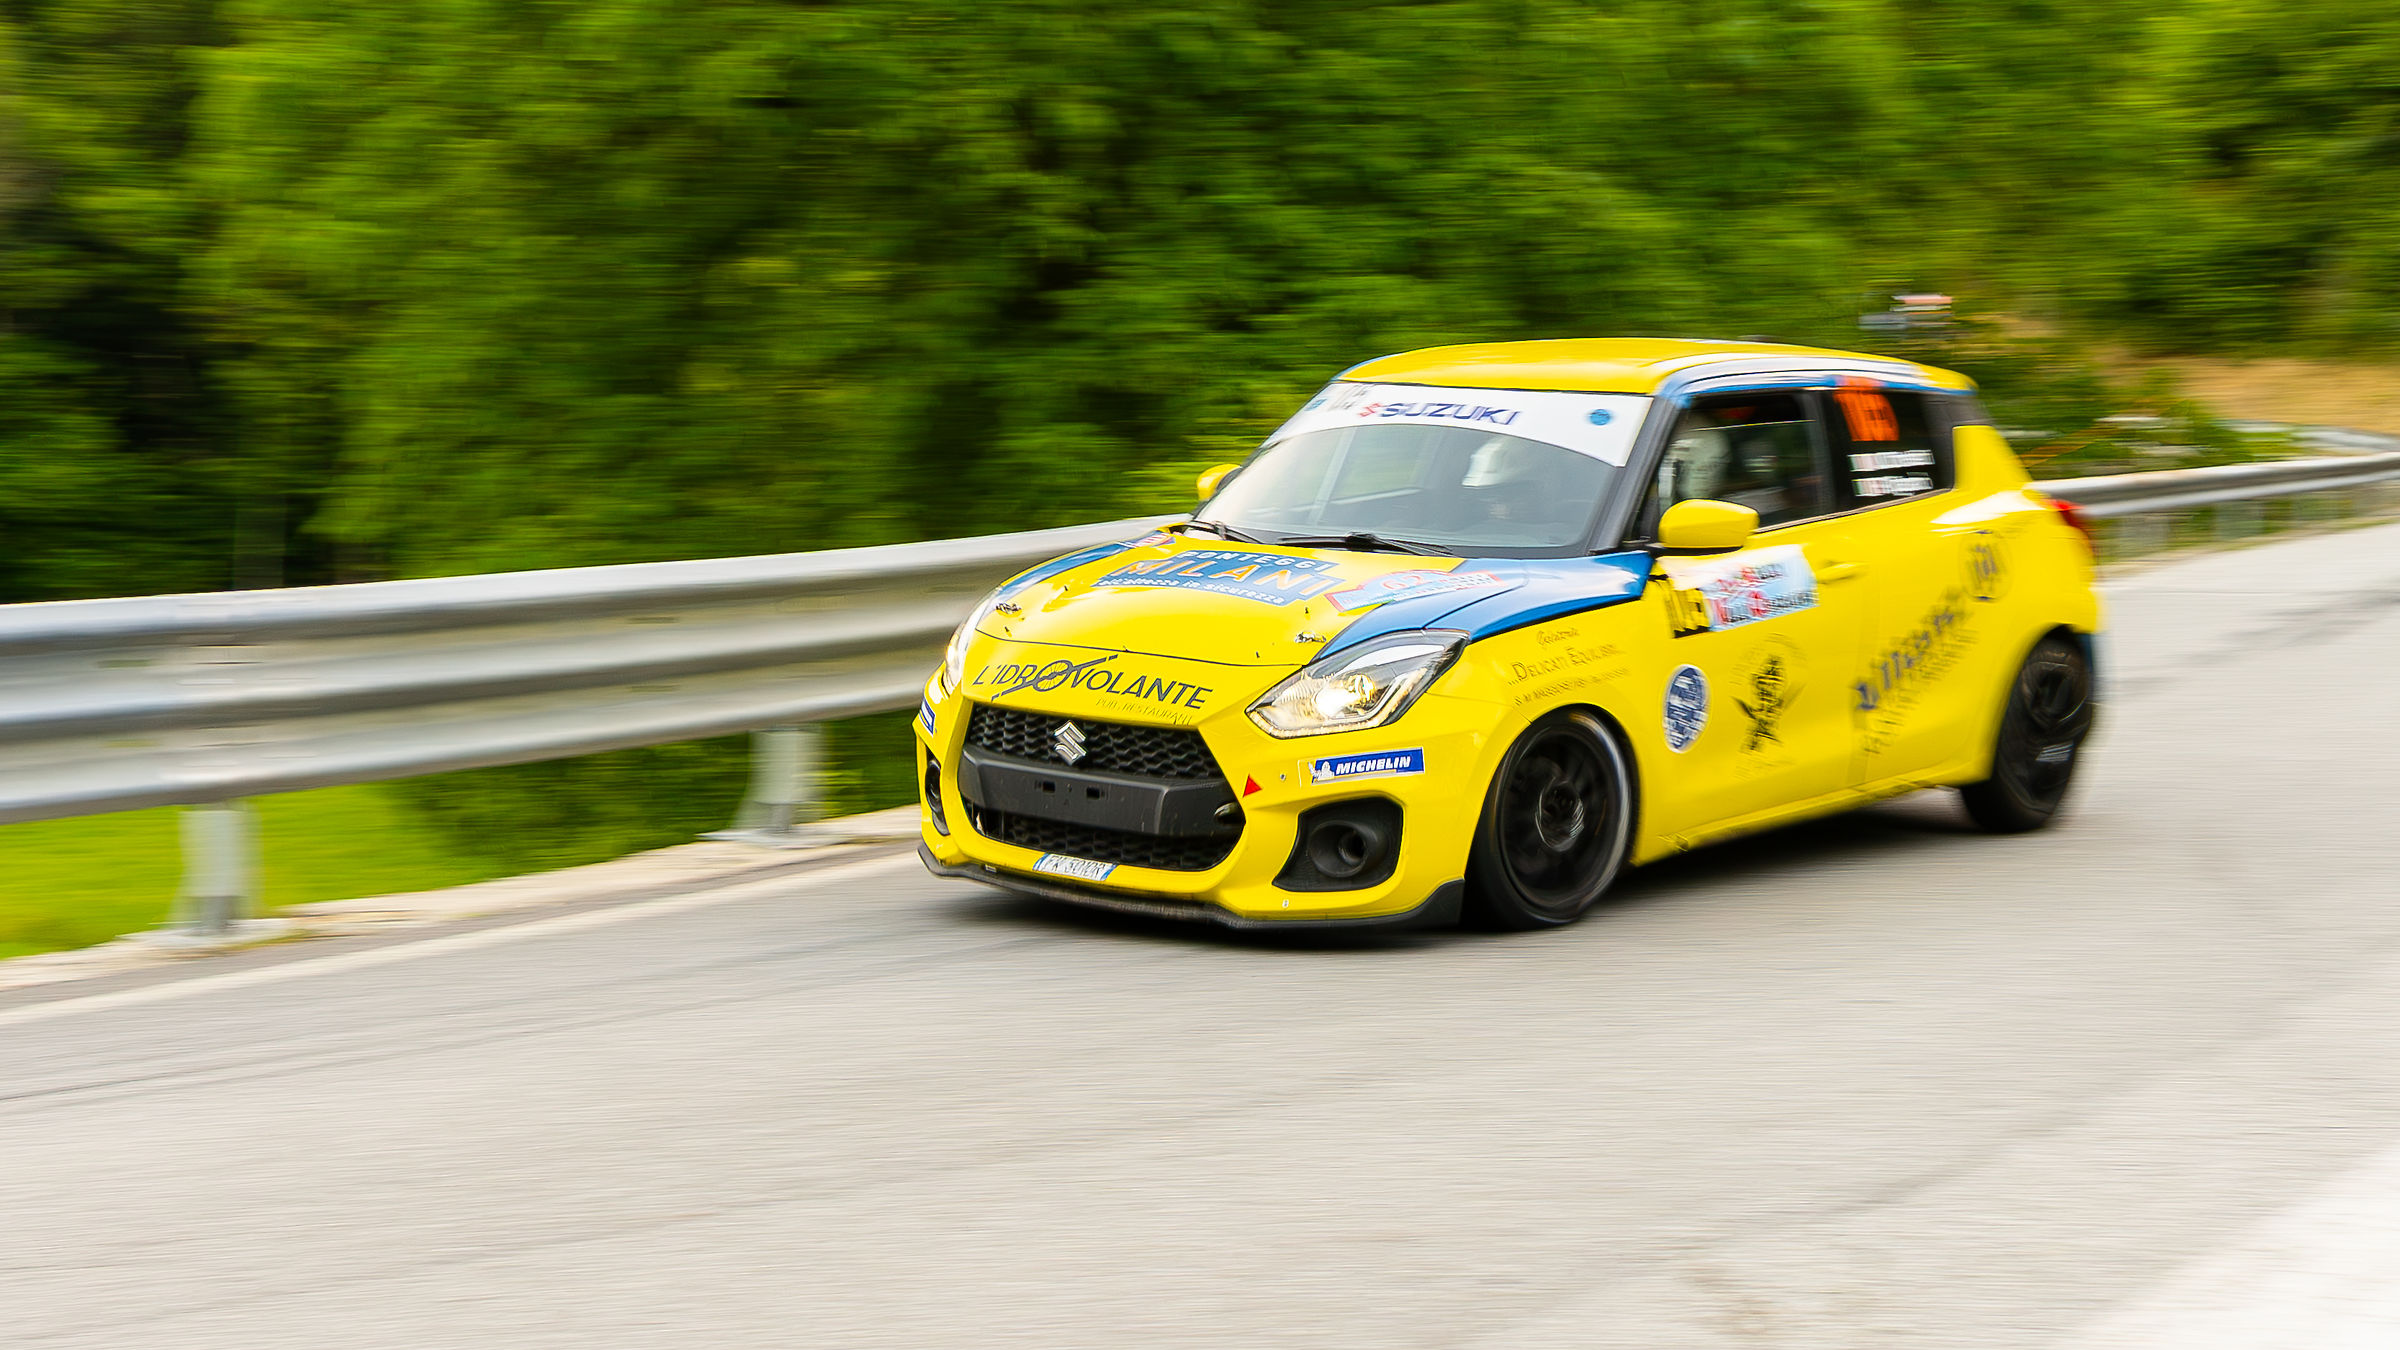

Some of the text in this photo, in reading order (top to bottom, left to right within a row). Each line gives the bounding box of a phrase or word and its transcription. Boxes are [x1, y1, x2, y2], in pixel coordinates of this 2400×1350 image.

[1380, 402, 1521, 425] SUZUKI
[1176, 551, 1330, 571] PONTEGGI
[1110, 560, 1335, 596] MILANI
[1204, 583, 1285, 604] sicurezza
[1336, 756, 1411, 775] MICHELIN
